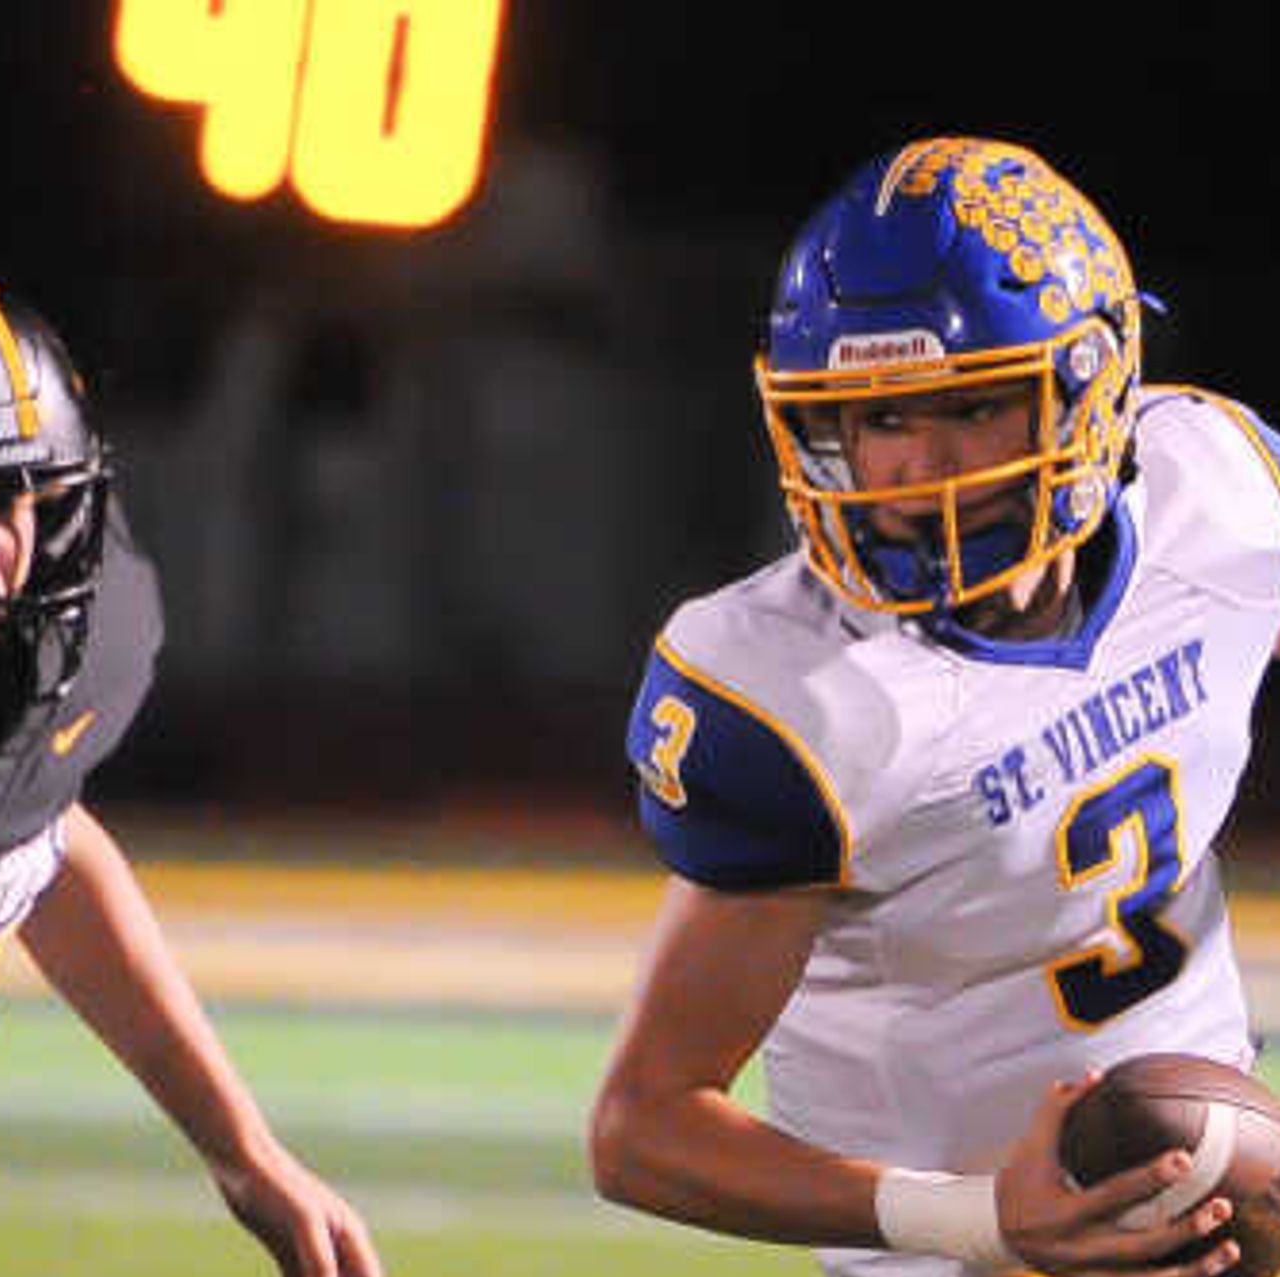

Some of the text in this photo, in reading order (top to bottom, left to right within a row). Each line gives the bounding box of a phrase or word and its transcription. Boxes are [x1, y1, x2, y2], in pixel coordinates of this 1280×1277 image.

[638, 695, 697, 808] 3
[976, 640, 1209, 827] ST. VINCENT
[1050, 751, 1192, 1034] 3
